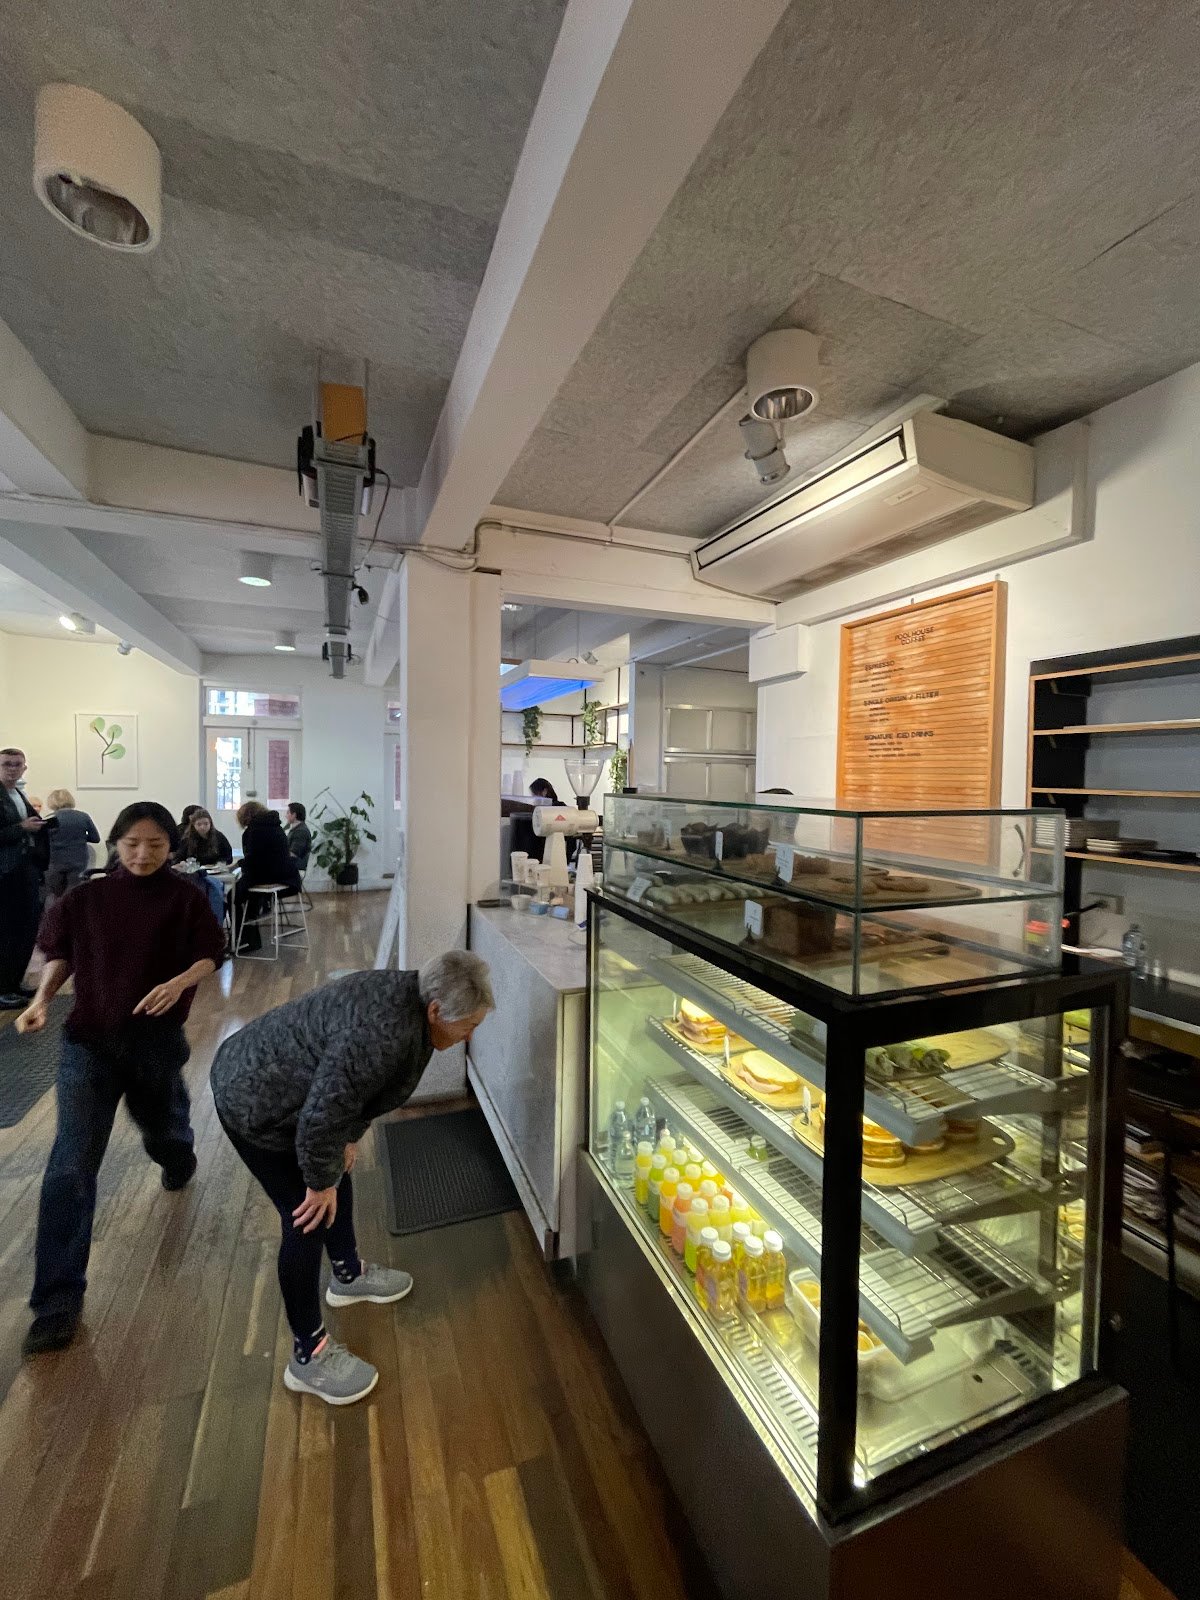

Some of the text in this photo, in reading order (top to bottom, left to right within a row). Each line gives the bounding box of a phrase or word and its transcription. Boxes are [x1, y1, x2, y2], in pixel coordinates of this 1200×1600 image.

[895, 627, 935, 641] POOL HOUSE
[901, 635, 926, 645] COFFEE
[865, 660, 895, 671] ESPRESSO
[864, 698, 884, 706] SINGLE
[885, 695, 907, 703] ORIGIN
[916, 691, 940, 699] FILTER
